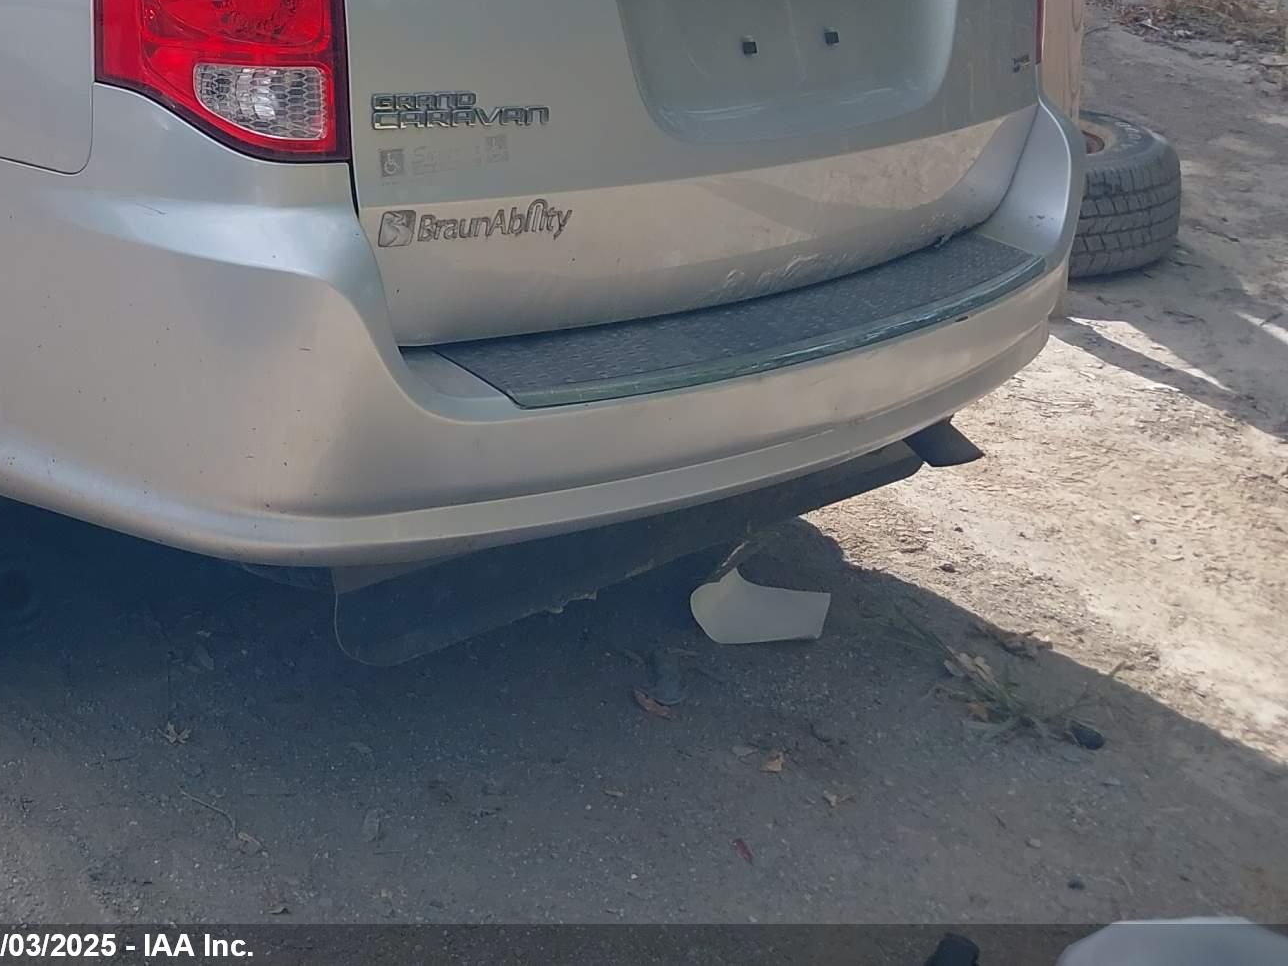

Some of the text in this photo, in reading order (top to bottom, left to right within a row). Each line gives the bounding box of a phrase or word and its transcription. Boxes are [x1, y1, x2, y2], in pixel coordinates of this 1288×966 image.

[371, 90, 477, 110] GRAND
[371, 106, 550, 130] CARAVAN
[416, 198, 573, 241] BraunAbility
